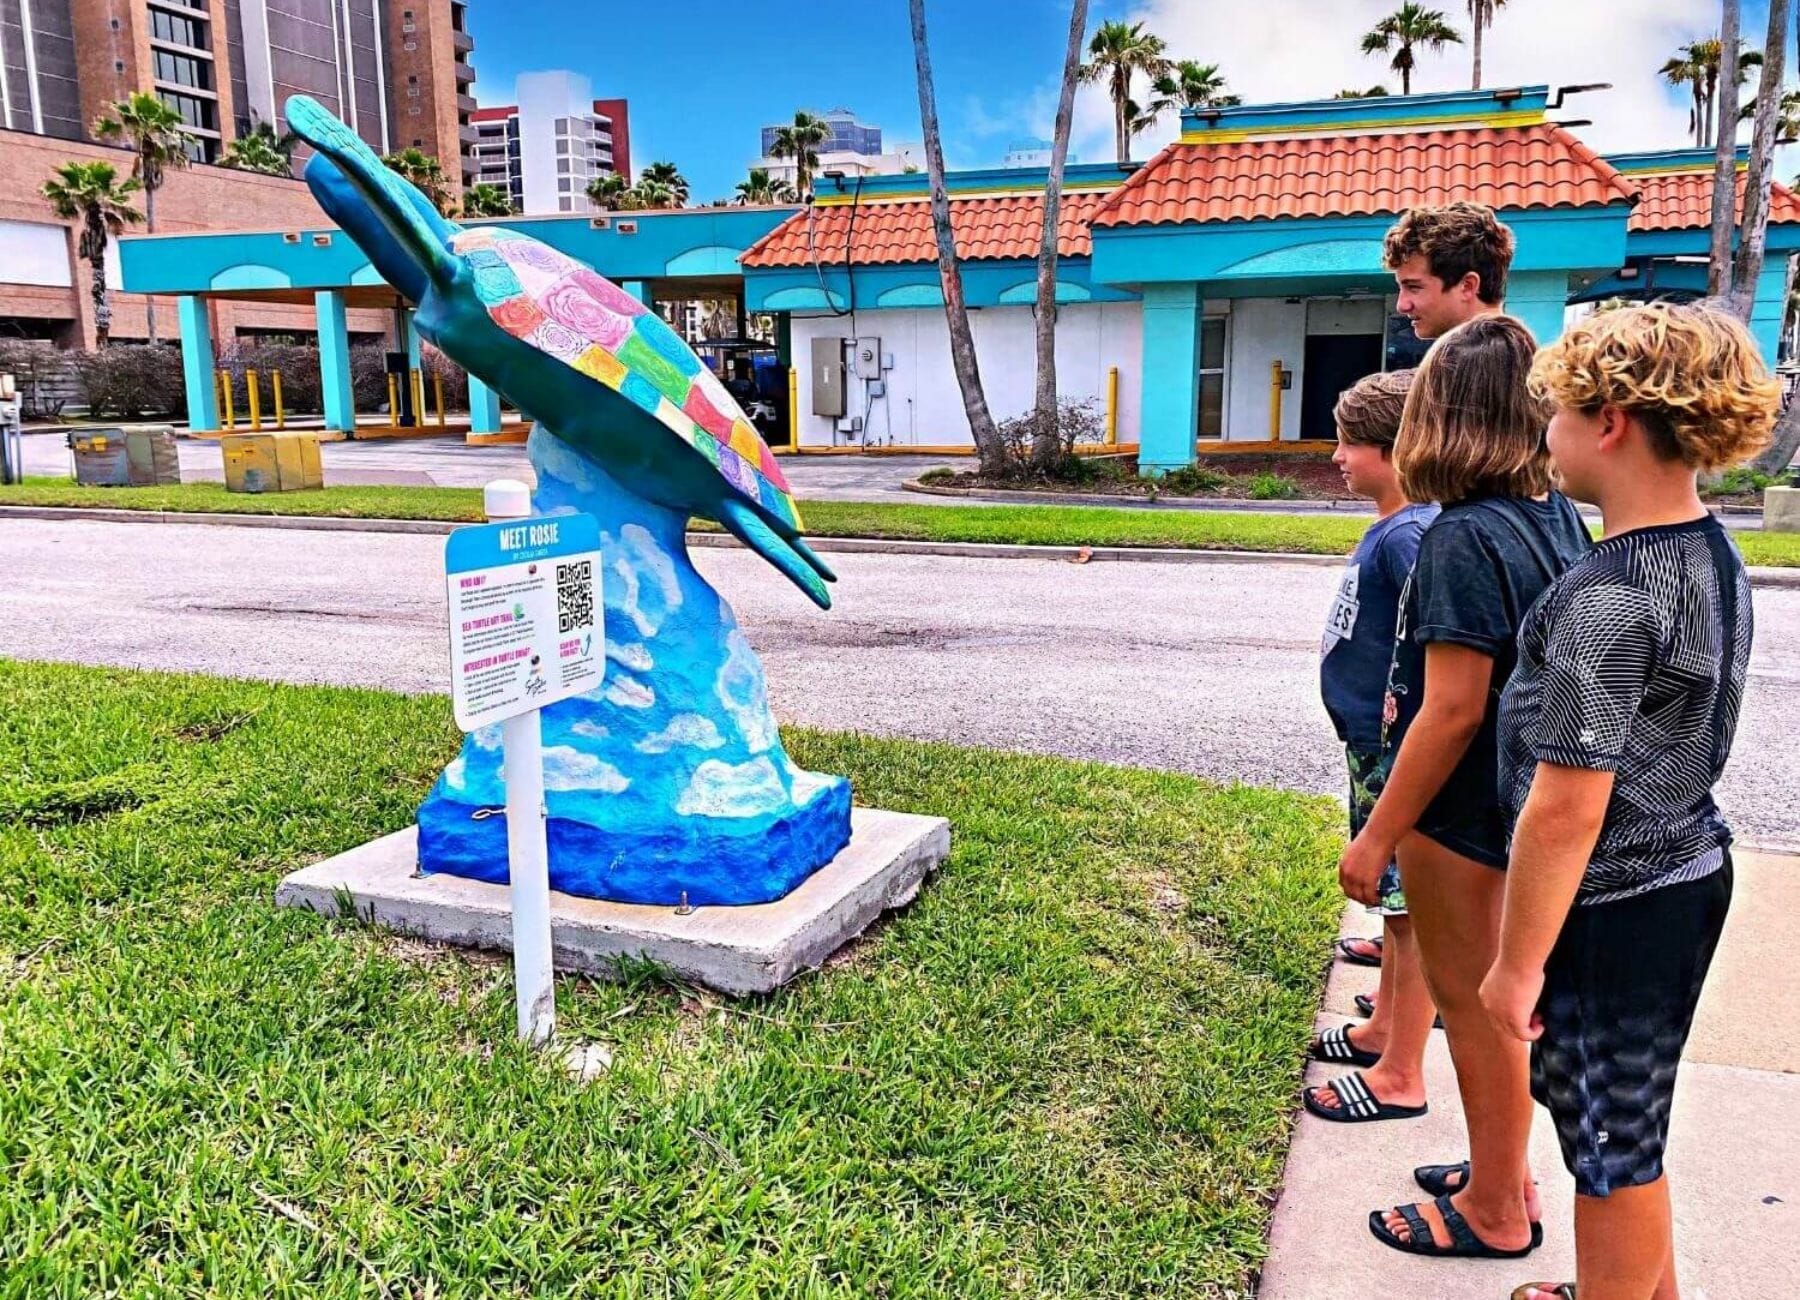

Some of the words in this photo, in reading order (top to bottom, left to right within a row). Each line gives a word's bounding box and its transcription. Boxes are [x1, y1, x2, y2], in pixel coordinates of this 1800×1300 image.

[500, 527, 528, 551] MEET
[530, 523, 558, 547] ROSIE
[472, 617, 490, 629] TURTLE
